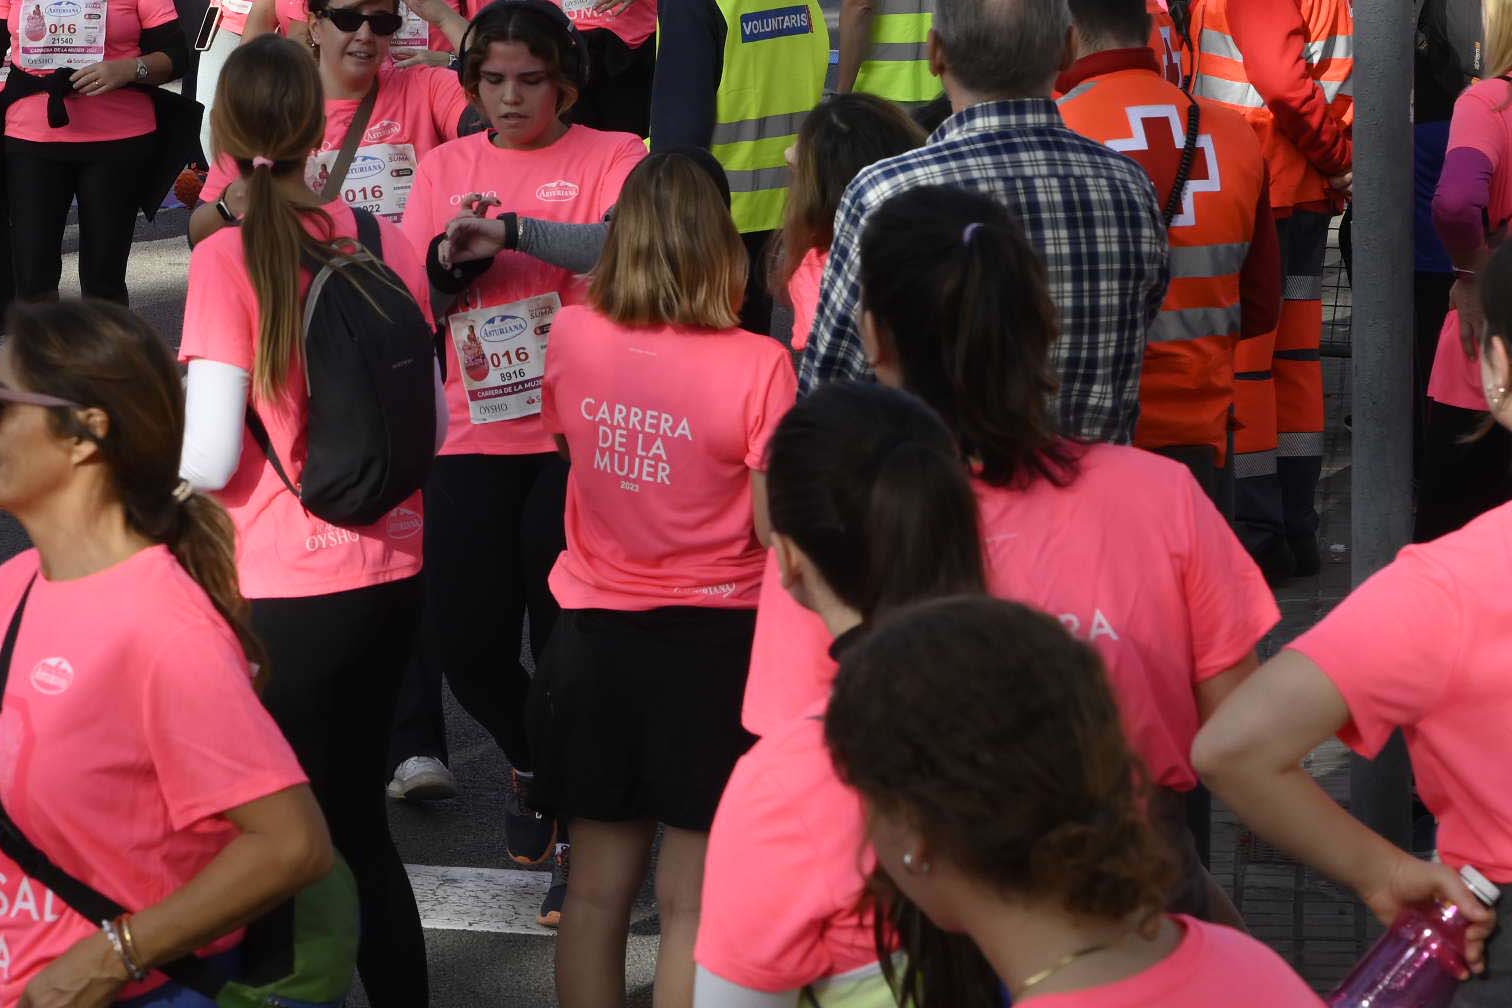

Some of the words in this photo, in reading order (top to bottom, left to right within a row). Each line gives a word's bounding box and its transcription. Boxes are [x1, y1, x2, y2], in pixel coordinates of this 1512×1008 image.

[49, 23, 77, 34] 016
[742, 13, 808, 35] VOLUNTARIS
[51, 37, 74, 45] 21540
[345, 184, 384, 203] 016
[482, 323, 525, 338] ASTURIANA
[490, 346, 530, 368] 016
[499, 368, 526, 382] 8916
[581, 397, 693, 441] CARRERA
[599, 425, 627, 452] DE
[637, 433, 667, 460] LA
[594, 447, 671, 485] MUJER
[305, 529, 360, 552] OYSHO
